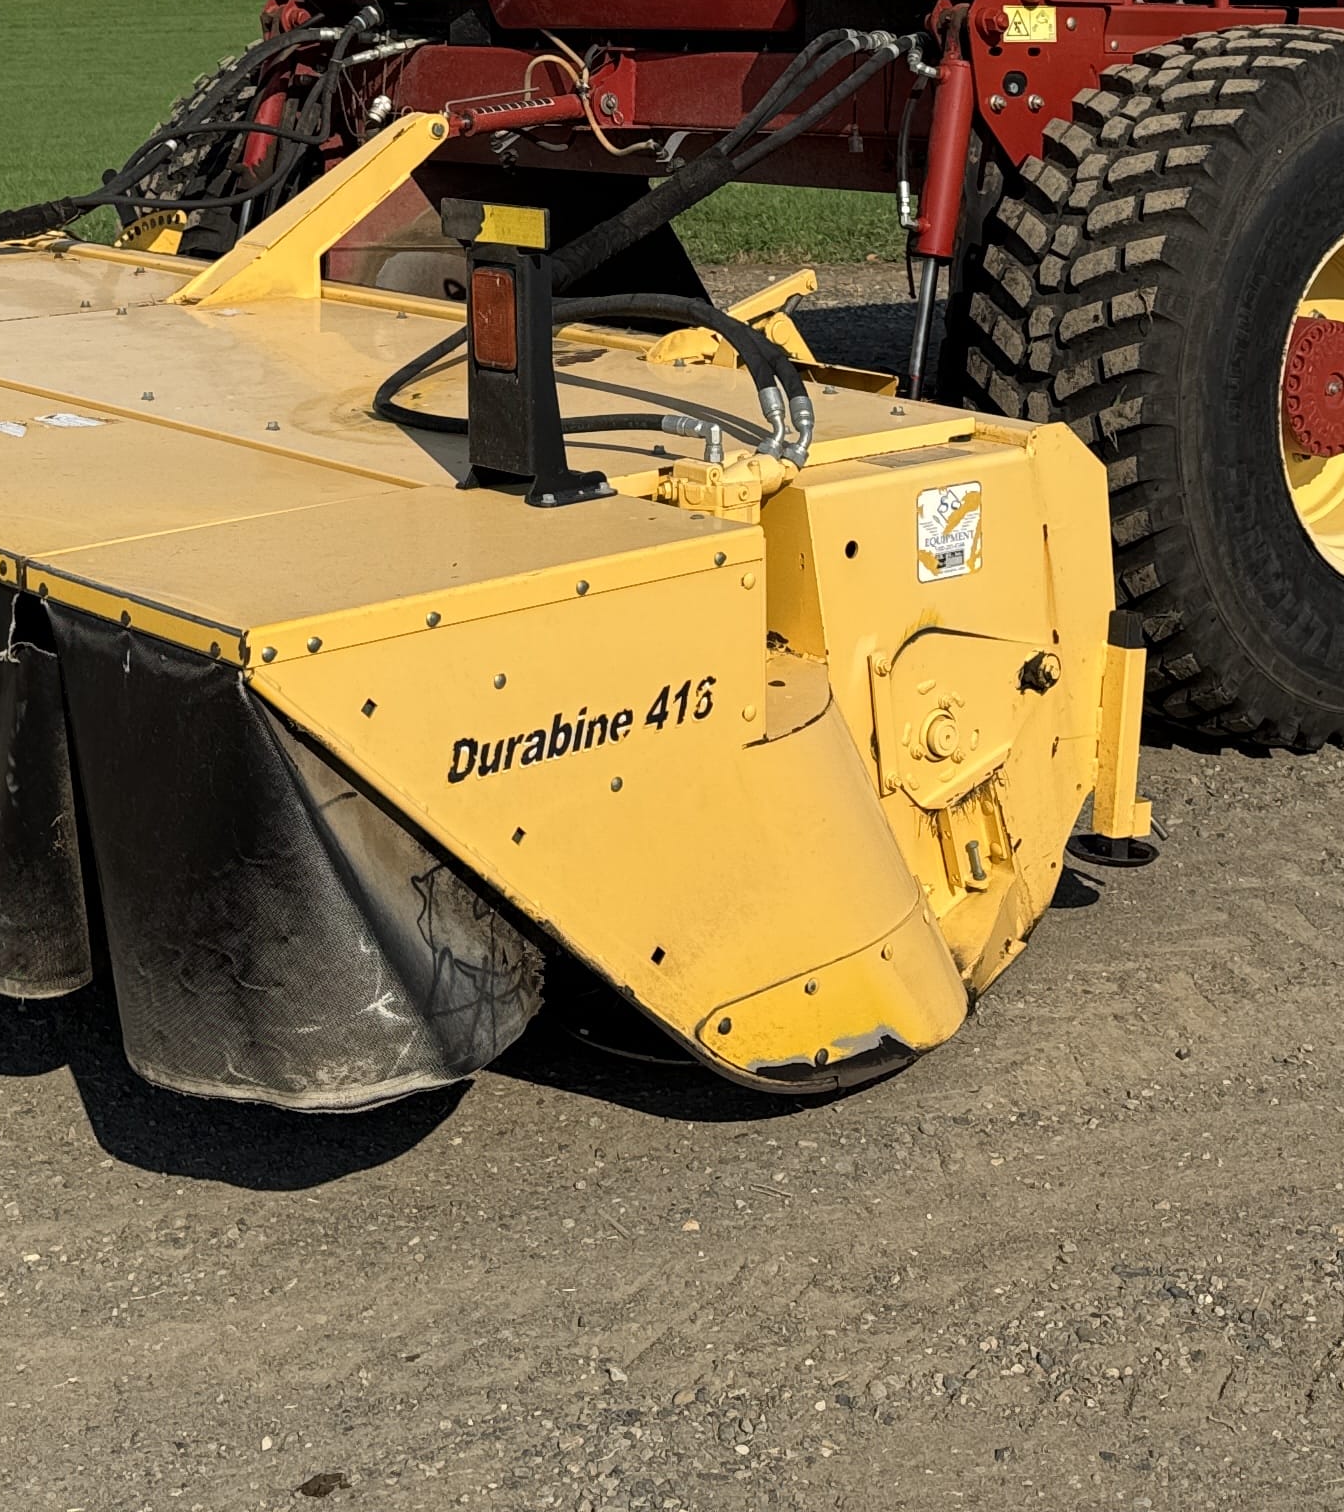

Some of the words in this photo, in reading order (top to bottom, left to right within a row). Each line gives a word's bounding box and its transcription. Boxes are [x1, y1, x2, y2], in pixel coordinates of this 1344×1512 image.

[924, 529, 974, 549] EQUIPMENT
[447, 706, 633, 784] Durabine
[644, 675, 717, 731] 416
